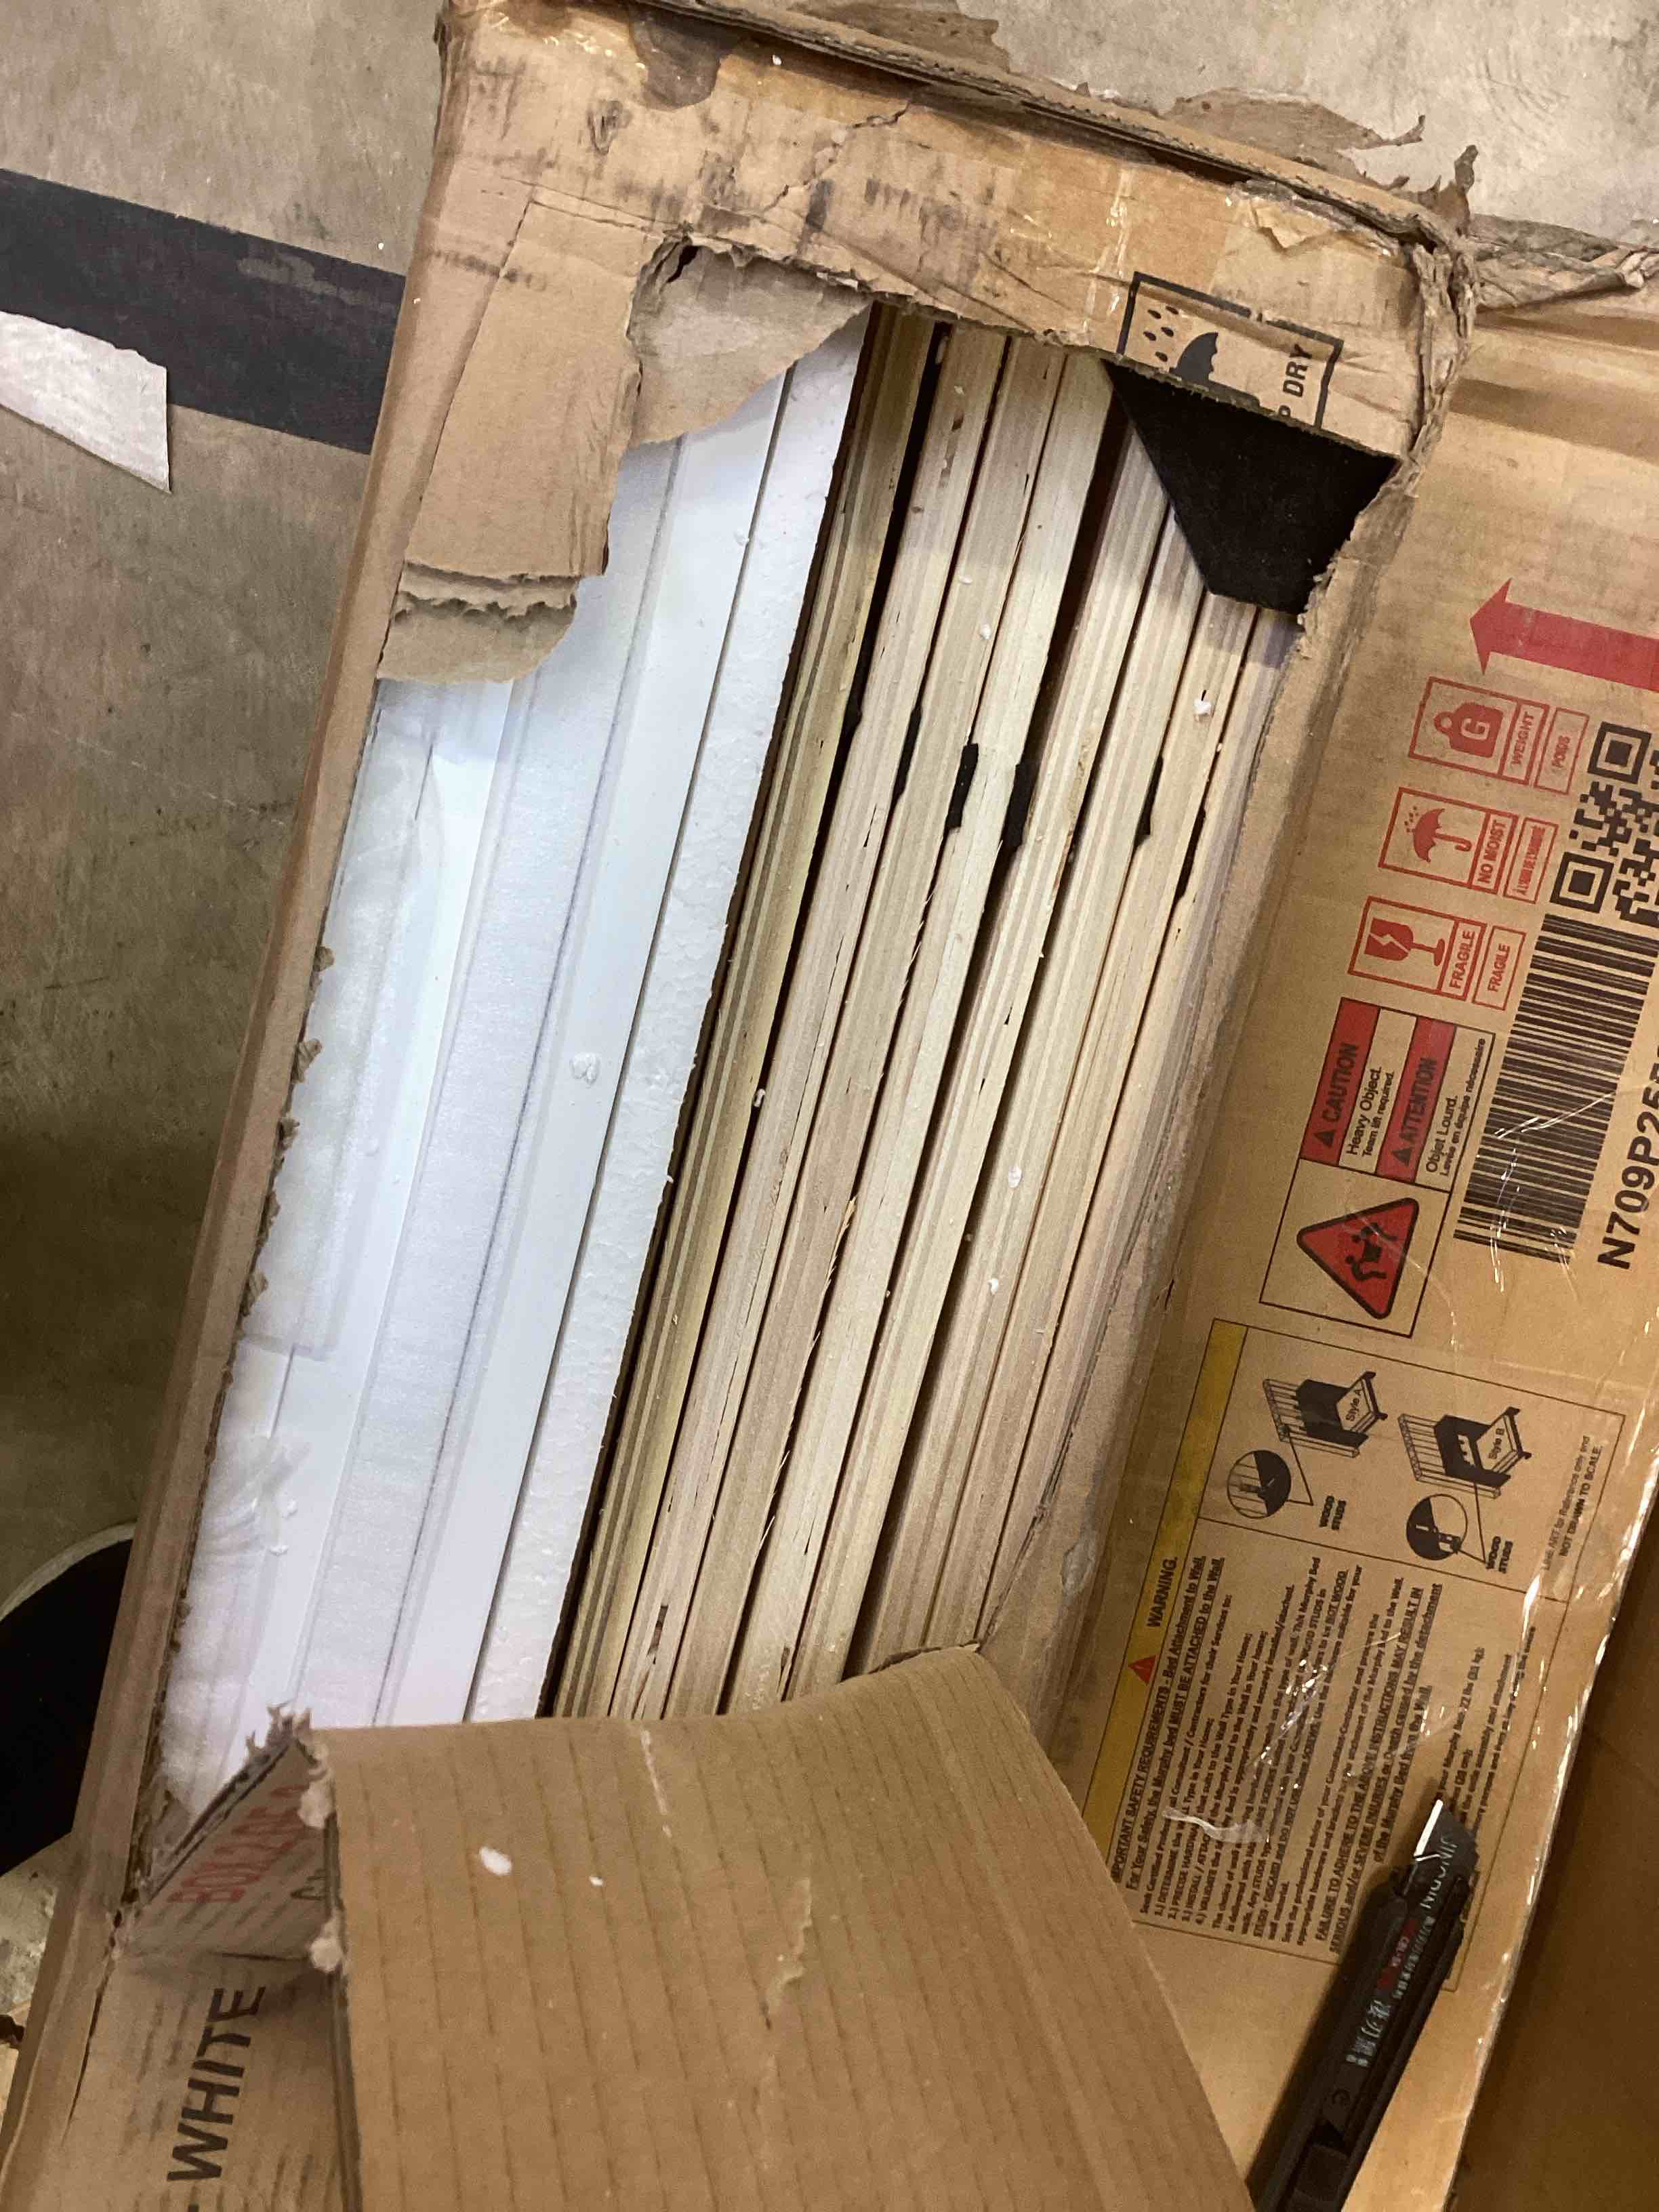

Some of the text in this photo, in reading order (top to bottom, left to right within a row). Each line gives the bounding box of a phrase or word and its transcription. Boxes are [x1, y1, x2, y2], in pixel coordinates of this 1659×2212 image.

[1282, 343, 1313, 398] DRY
[1510, 711, 1536, 766] WEIGHT
[1477, 819, 1507, 884] NO MOIST
[1448, 928, 1476, 989] FRAGILE
[1486, 942, 1511, 993] FRAGILE
[1320, 1040, 1359, 1124] CAUTION
[1345, 1063, 1385, 1156] Heavy Object.
[1361, 1069, 1397, 1158] Team lift required.
[1397, 1056, 1437, 1145] ATTENTION
[1423, 1092, 1458, 1174] Objet Lourd.
[1345, 1387, 1363, 1422] Style A
[1488, 1441, 1502, 1460] Style
[1317, 1494, 1335, 1528] WOOD
[1330, 1498, 1347, 1532] STUDS
[1559, 1443, 1603, 1557] NOT DRAWN TO SCALE.
[1485, 1535, 1502, 1570] WOOD
[1496, 1539, 1514, 1574] STUDS
[1147, 1555, 1177, 1627] WARNING.
[1185, 1582, 1198, 1594] to
[1202, 1583, 1217, 1601] the
[1410, 1586, 1424, 1599] IN
[1168, 1595, 1195, 1656] Attachment
[1198, 1602, 1212, 1614] to
[1397, 1601, 1420, 1643] RESULT
[1182, 1616, 1208, 1675] ATTACHED
[1391, 1645, 1408, 1668] MAY
[1162, 1658, 1178, 1677] Bed
[1178, 1675, 1193, 1692] BE
[1201, 1672, 1212, 1685] for
[1169, 1693, 1188, 1724] MUST
[1368, 1671, 1400, 1750] INSTRUCTIONS
[1136, 1685, 1170, 1773] REQUIREMENTS
[1152, 1746, 1174, 1788] Murphy
[1124, 1774, 1147, 1817] SAFETY
[1147, 1790, 1162, 1807] the
[1350, 1792, 1366, 1813] THE
[1345, 1815, 1359, 1831] TO
[1374, 1831, 1390, 1849] the
[1130, 1843, 1148, 1874] Your
[1332, 1832, 1355, 1877] ADHERE
[1371, 1849, 1385, 1862] of
[1126, 1875, 1139, 1889] For
[1328, 1878, 1342, 1893] TO
[1314, 1896, 1336, 1940] FAILURE
[167, 1986, 266, 2182] WHITE
